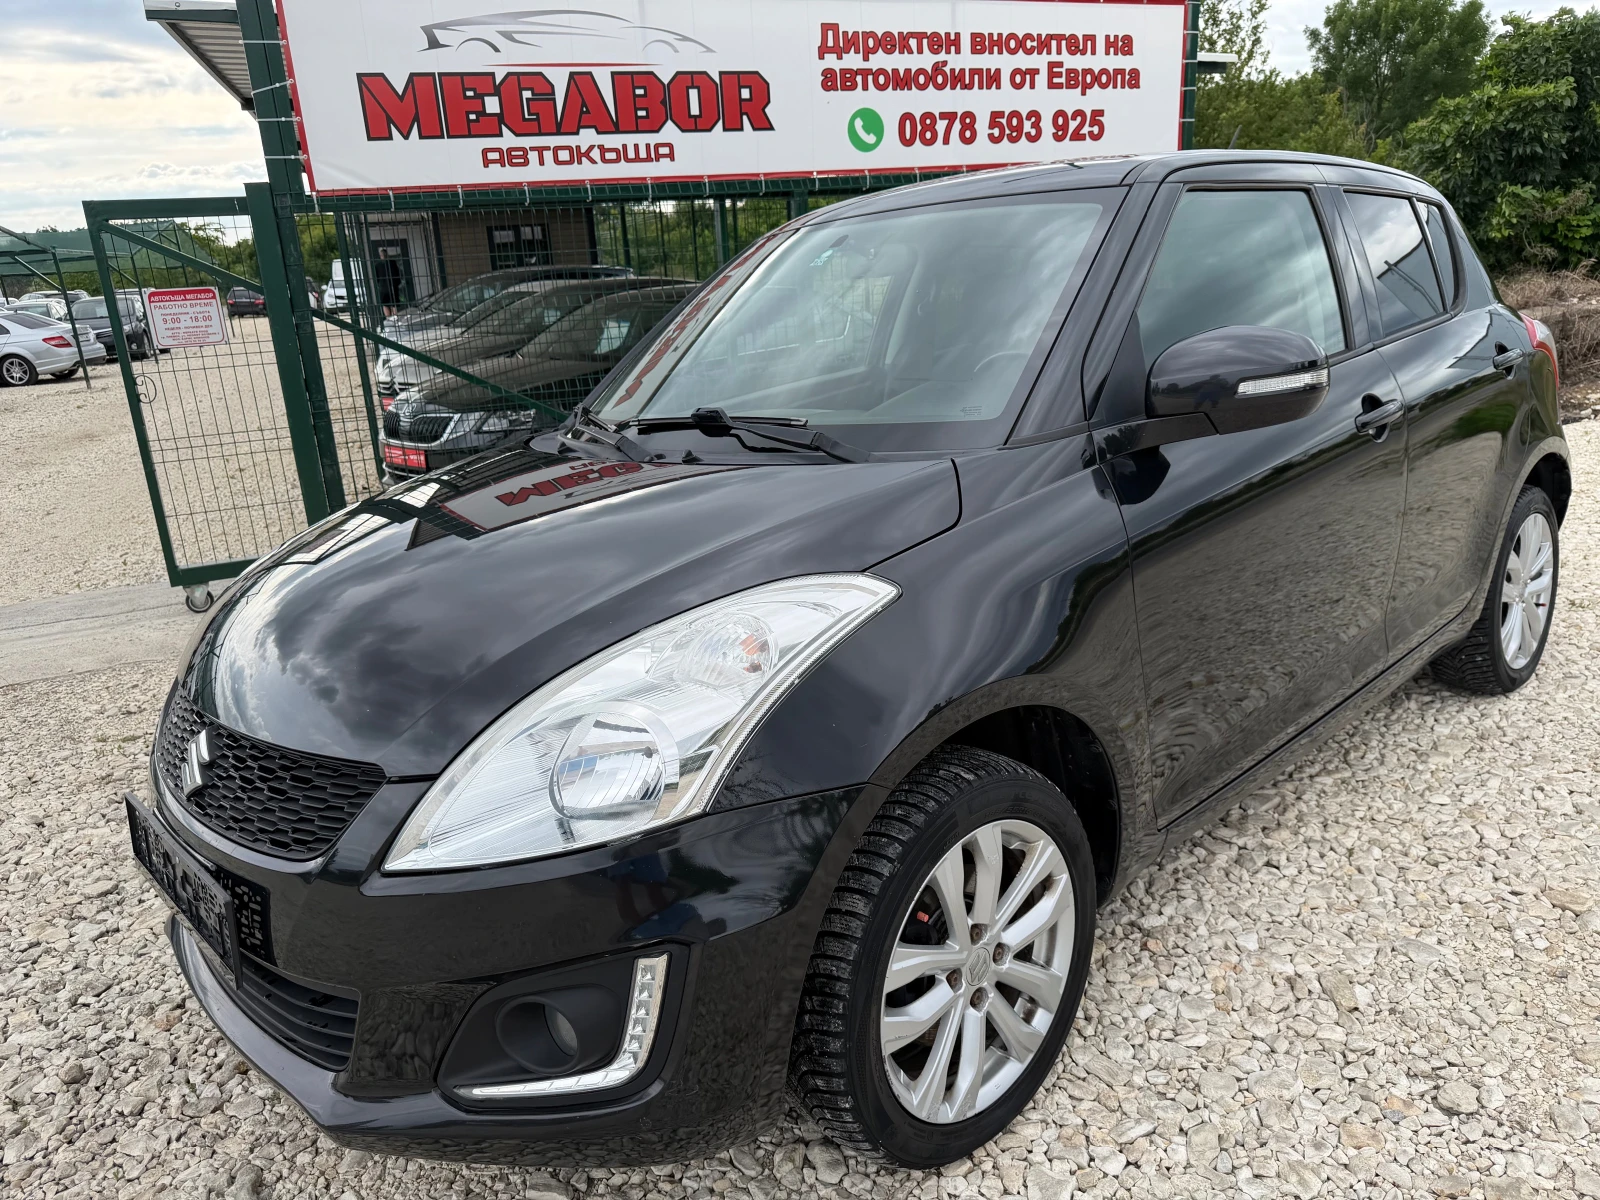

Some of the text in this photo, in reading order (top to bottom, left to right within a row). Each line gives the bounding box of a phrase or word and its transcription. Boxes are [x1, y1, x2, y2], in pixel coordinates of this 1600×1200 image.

[818, 23, 1134, 61] Директен вносител на
[820, 60, 1140, 96] автомобили от Европа
[356, 71, 775, 141] MEGABOR
[898, 109, 1105, 147] 0878 593 925
[482, 142, 675, 168] АВТОКЪЩА
